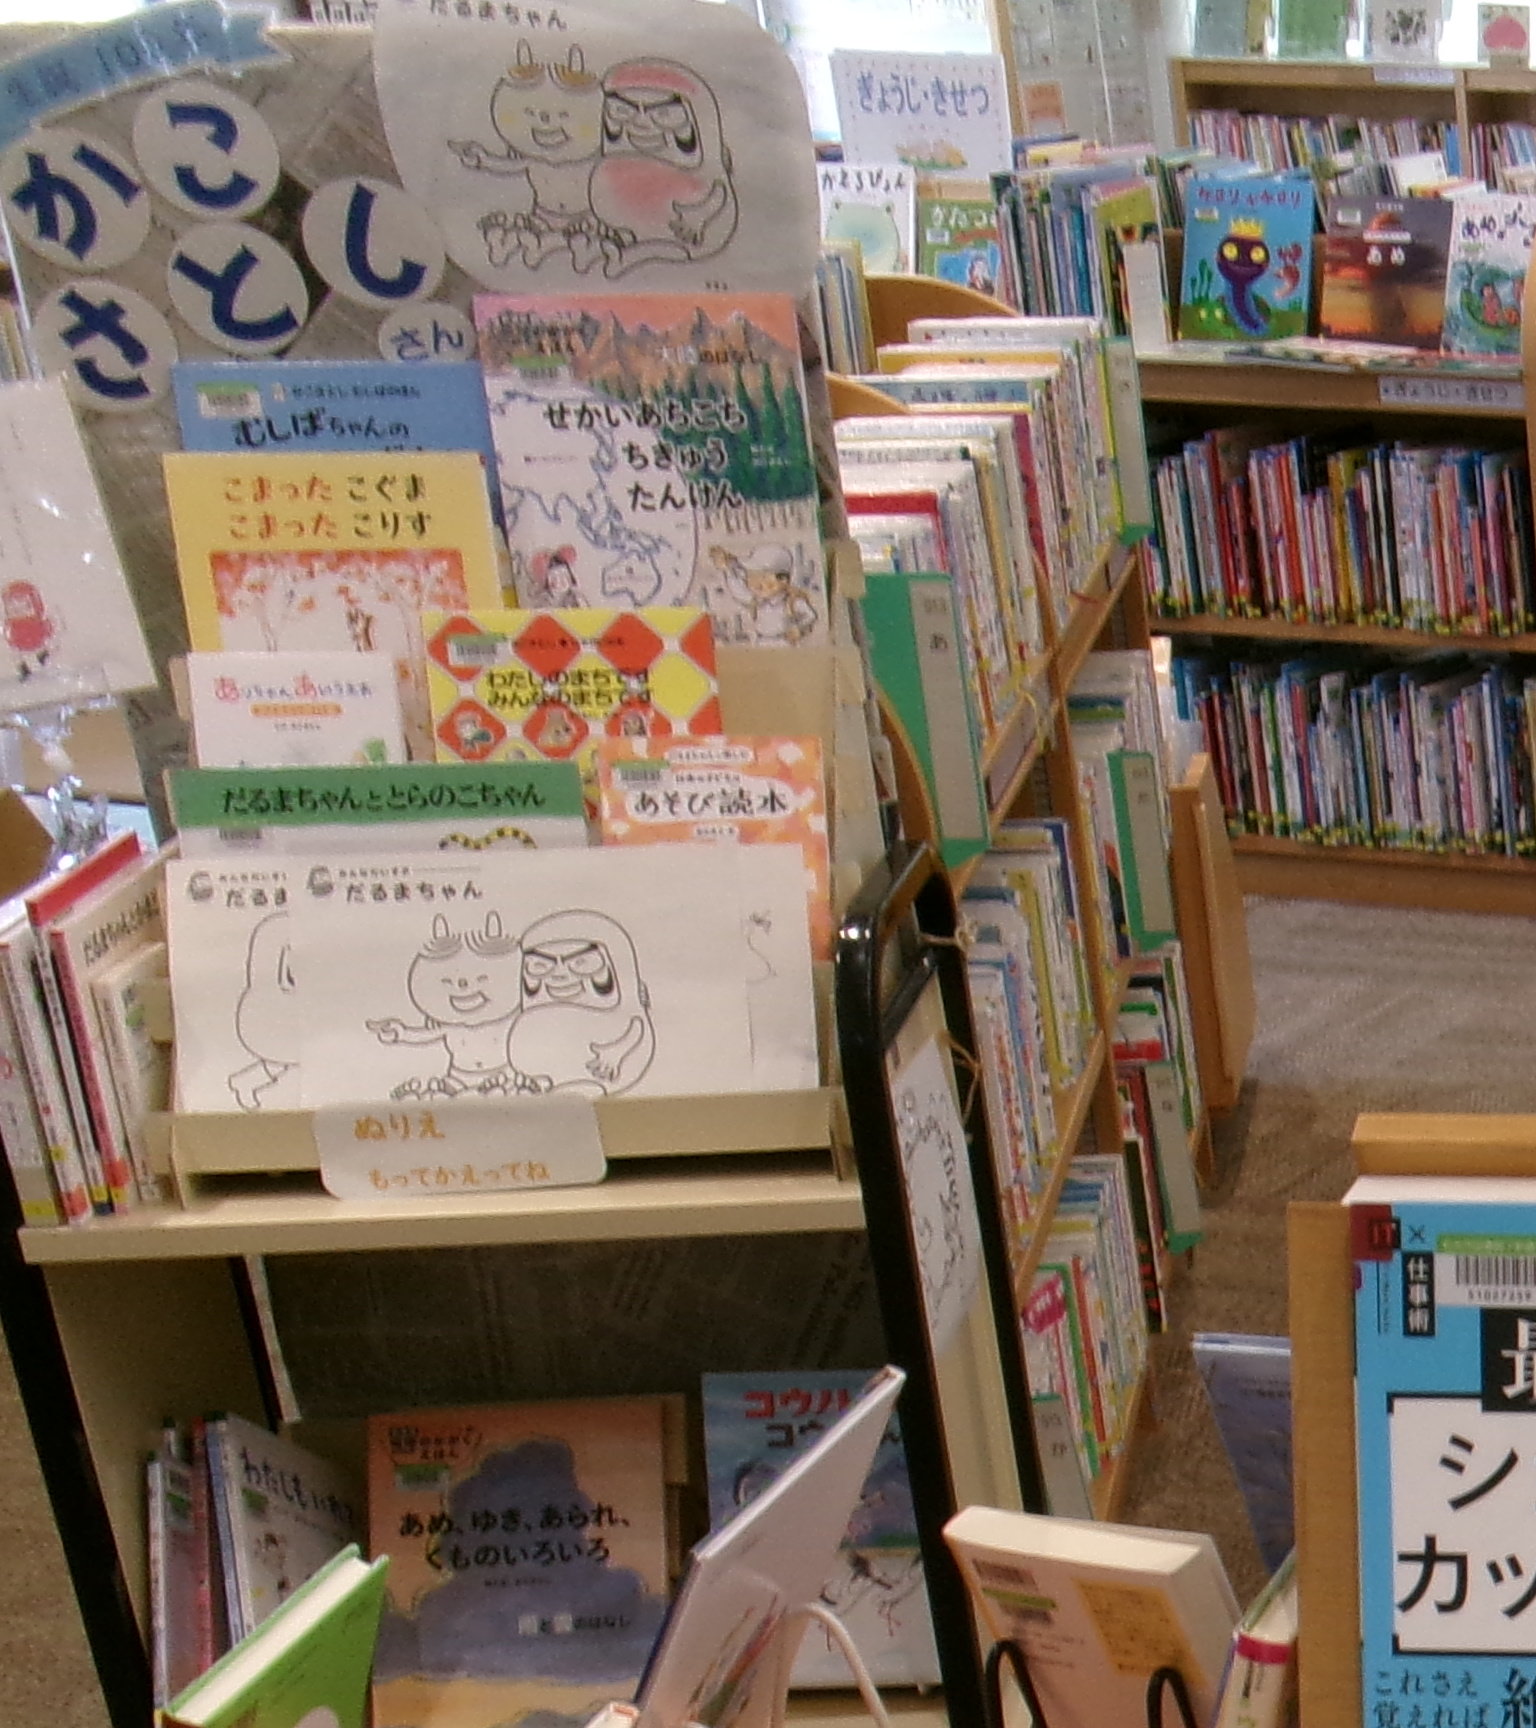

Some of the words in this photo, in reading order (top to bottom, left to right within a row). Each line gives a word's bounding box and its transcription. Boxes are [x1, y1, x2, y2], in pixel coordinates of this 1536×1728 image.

[857, 70, 990, 117] ぎょうじ・きせつ
[390, 316, 468, 358] さん
[543, 400, 748, 432] せかいあちこち
[621, 440, 728, 472] ちきゅう
[223, 475, 334, 502] こまった
[346, 474, 427, 501] こぐま
[628, 480, 744, 512] たんけん
[229, 512, 338, 539] こまった
[353, 509, 434, 538] こりす
[221, 784, 547, 816] だるまちゃんととらのこちゃん
[633, 788, 788, 816] あそび読本
[346, 881, 483, 904] だるまちゃん
[353, 1110, 446, 1141] ぬりえ
[366, 1160, 552, 1190] もってかえってね
[1405, 1256, 1432, 1334] 仕事術
[399, 1500, 630, 1534] あめ、ゆき、あられ、
[425, 1538, 610, 1570] くものいろいろ
[1374, 1670, 1479, 1697] これさえ
